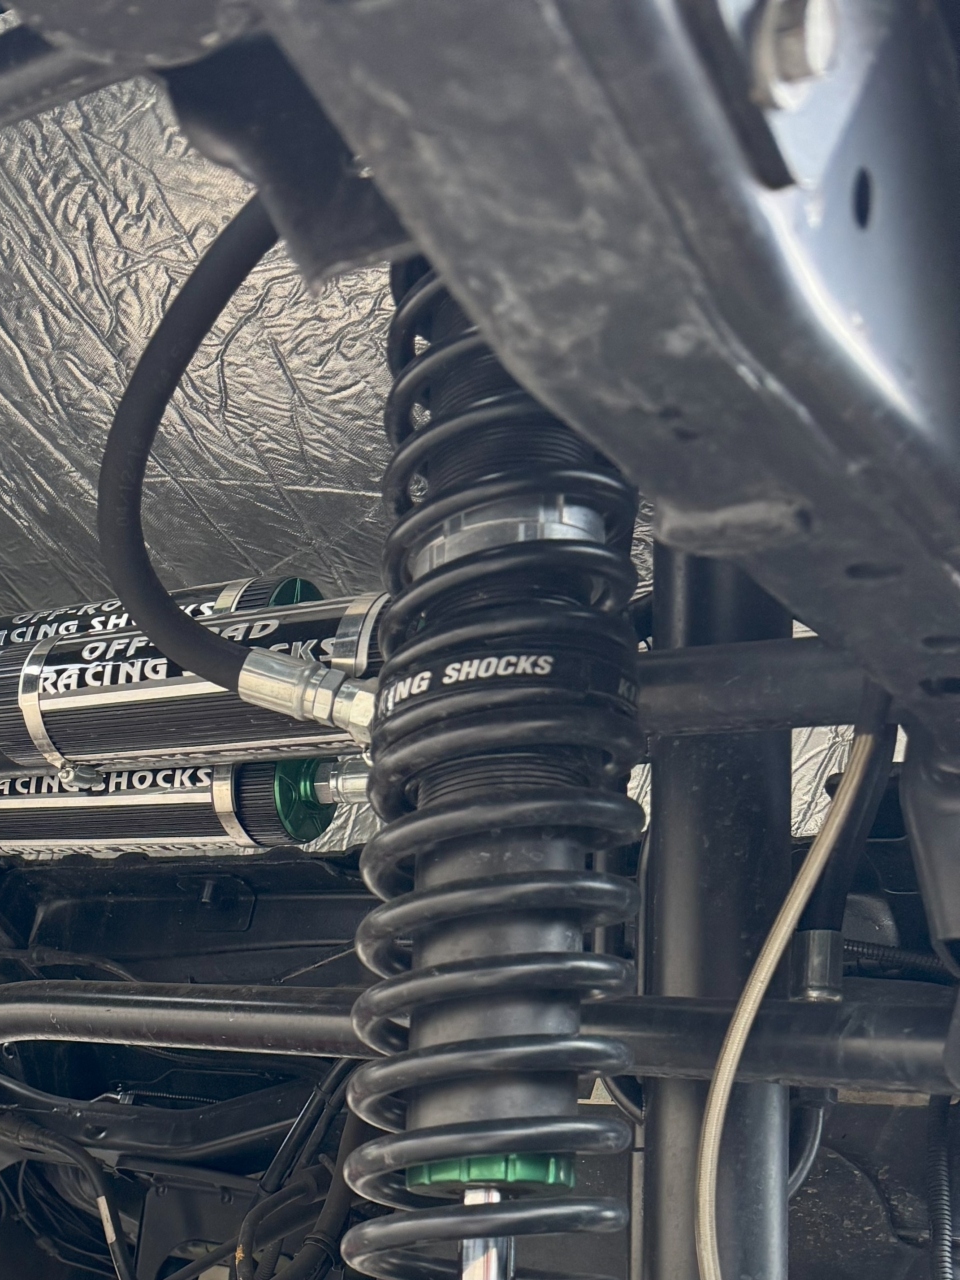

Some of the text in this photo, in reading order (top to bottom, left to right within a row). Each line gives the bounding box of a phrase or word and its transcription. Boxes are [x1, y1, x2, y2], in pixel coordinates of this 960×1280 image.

[12, 600, 126, 625] OFF-RO
[40, 656, 168, 695] RACING
[442, 655, 555, 685] SHOCKS
